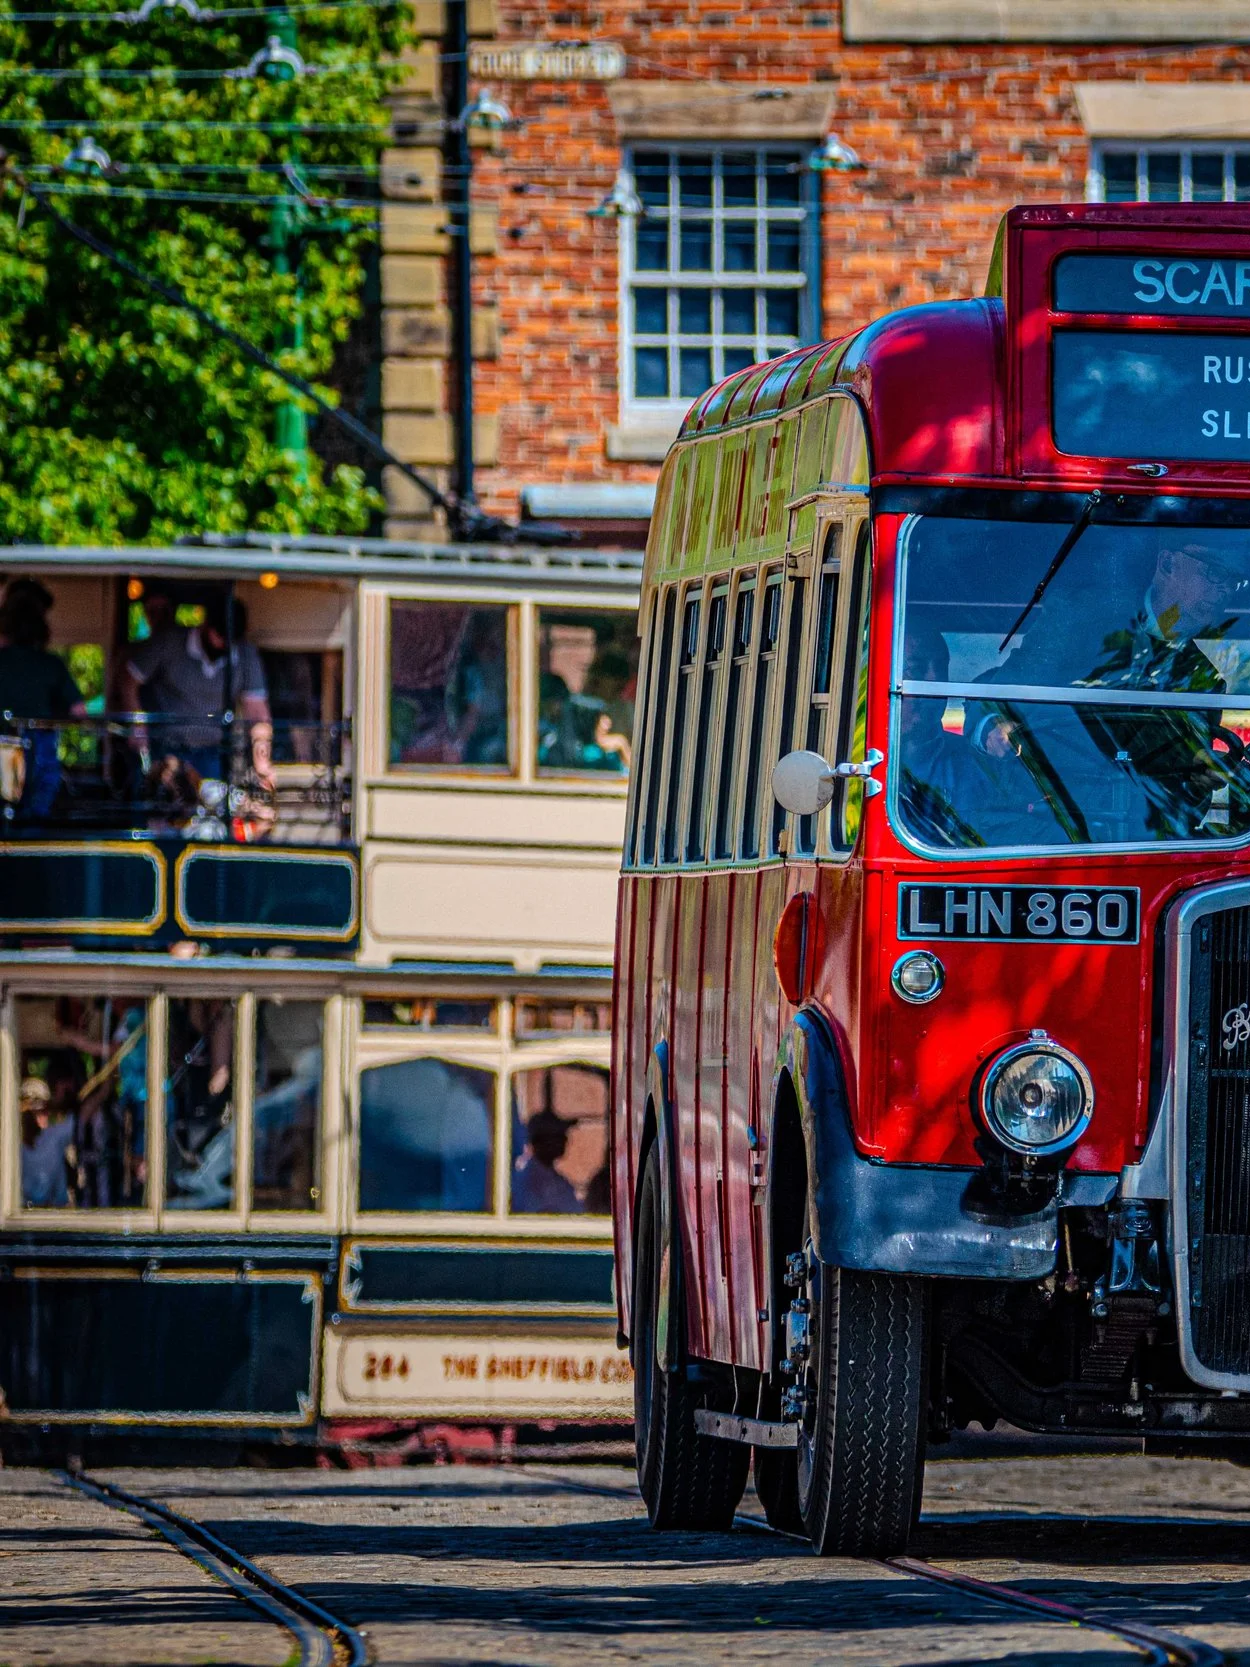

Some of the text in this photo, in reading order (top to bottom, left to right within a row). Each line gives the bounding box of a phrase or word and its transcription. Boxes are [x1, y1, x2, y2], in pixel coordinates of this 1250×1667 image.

[909, 889, 1129, 937] LHN 860
[442, 1354, 479, 1381] THE
[485, 1354, 598, 1384] SHEFFIELD
